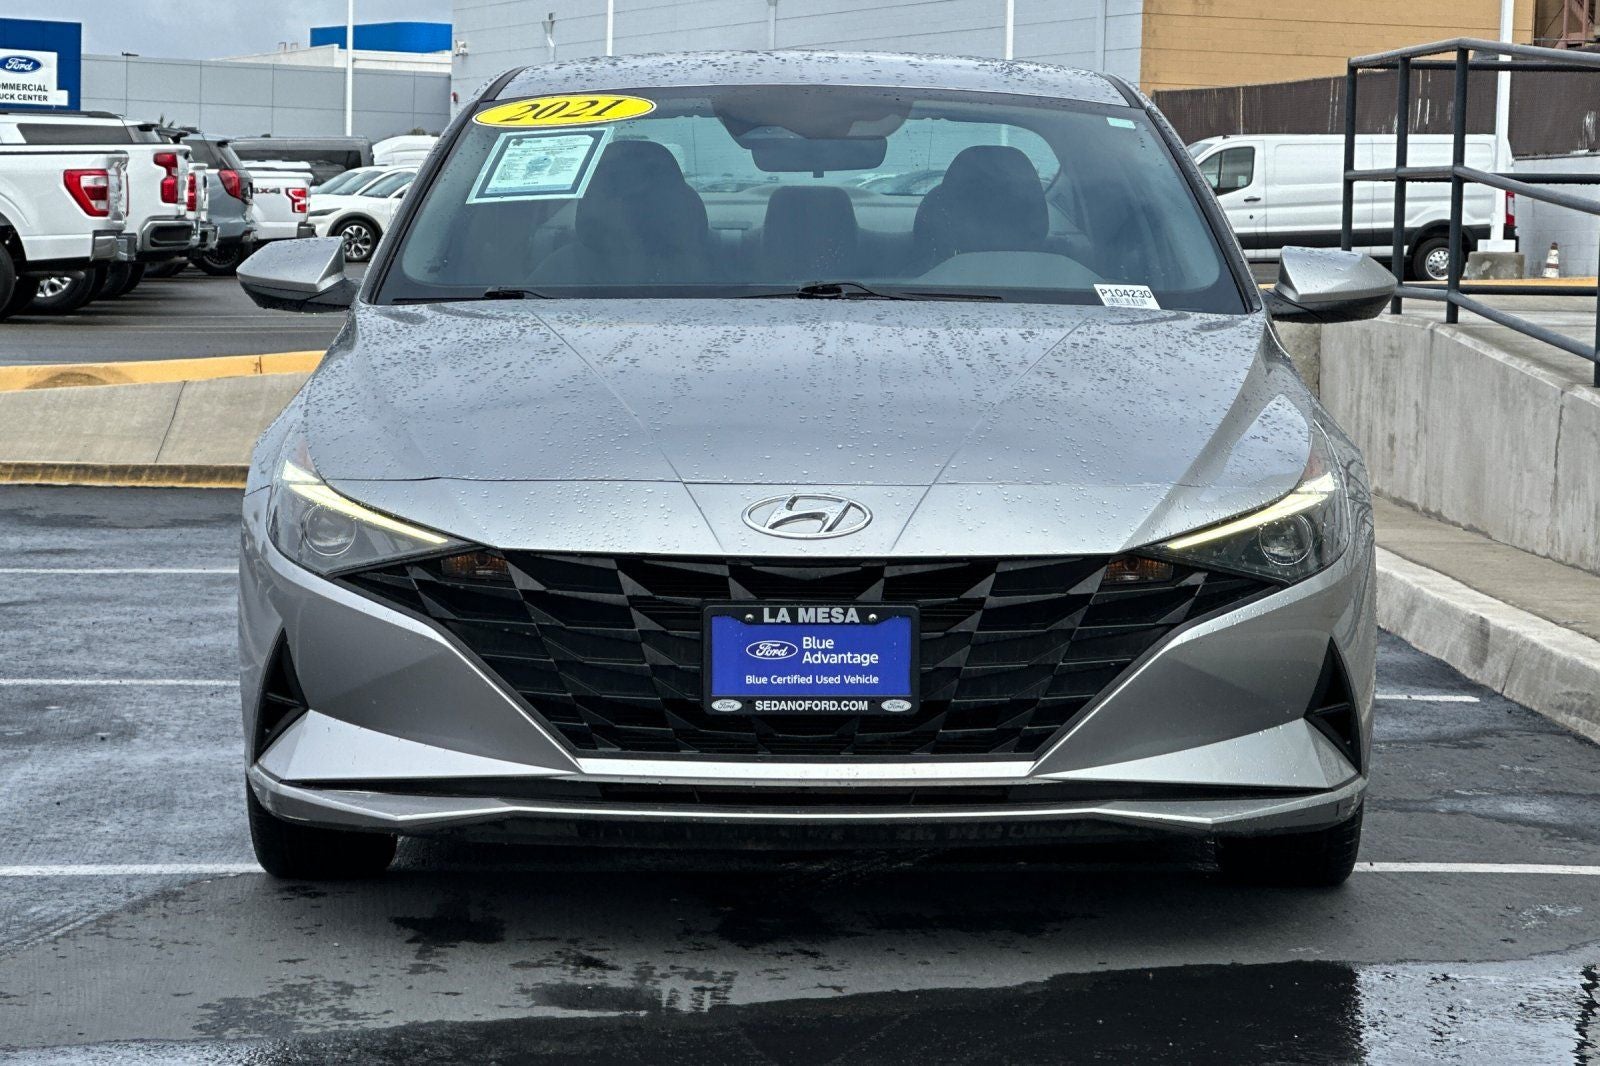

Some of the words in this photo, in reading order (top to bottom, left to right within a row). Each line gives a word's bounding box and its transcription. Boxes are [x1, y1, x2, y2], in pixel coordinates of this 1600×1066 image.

[5, 58, 33, 71] Ford
[0, 82, 48, 92] MMERCIAL
[499, 99, 627, 122] 2021
[1099, 288, 1152, 299] P104230
[763, 607, 791, 623] LA
[798, 607, 860, 623] MESA
[802, 636, 835, 649] Blue
[755, 642, 788, 657] Ford
[802, 651, 879, 666] Advantage
[745, 675, 768, 685] Blue
[770, 675, 813, 685] Certified
[816, 675, 841, 685] Used
[844, 675, 879, 685] Vehicle
[755, 700, 869, 712] SEDANOFORD.COM
